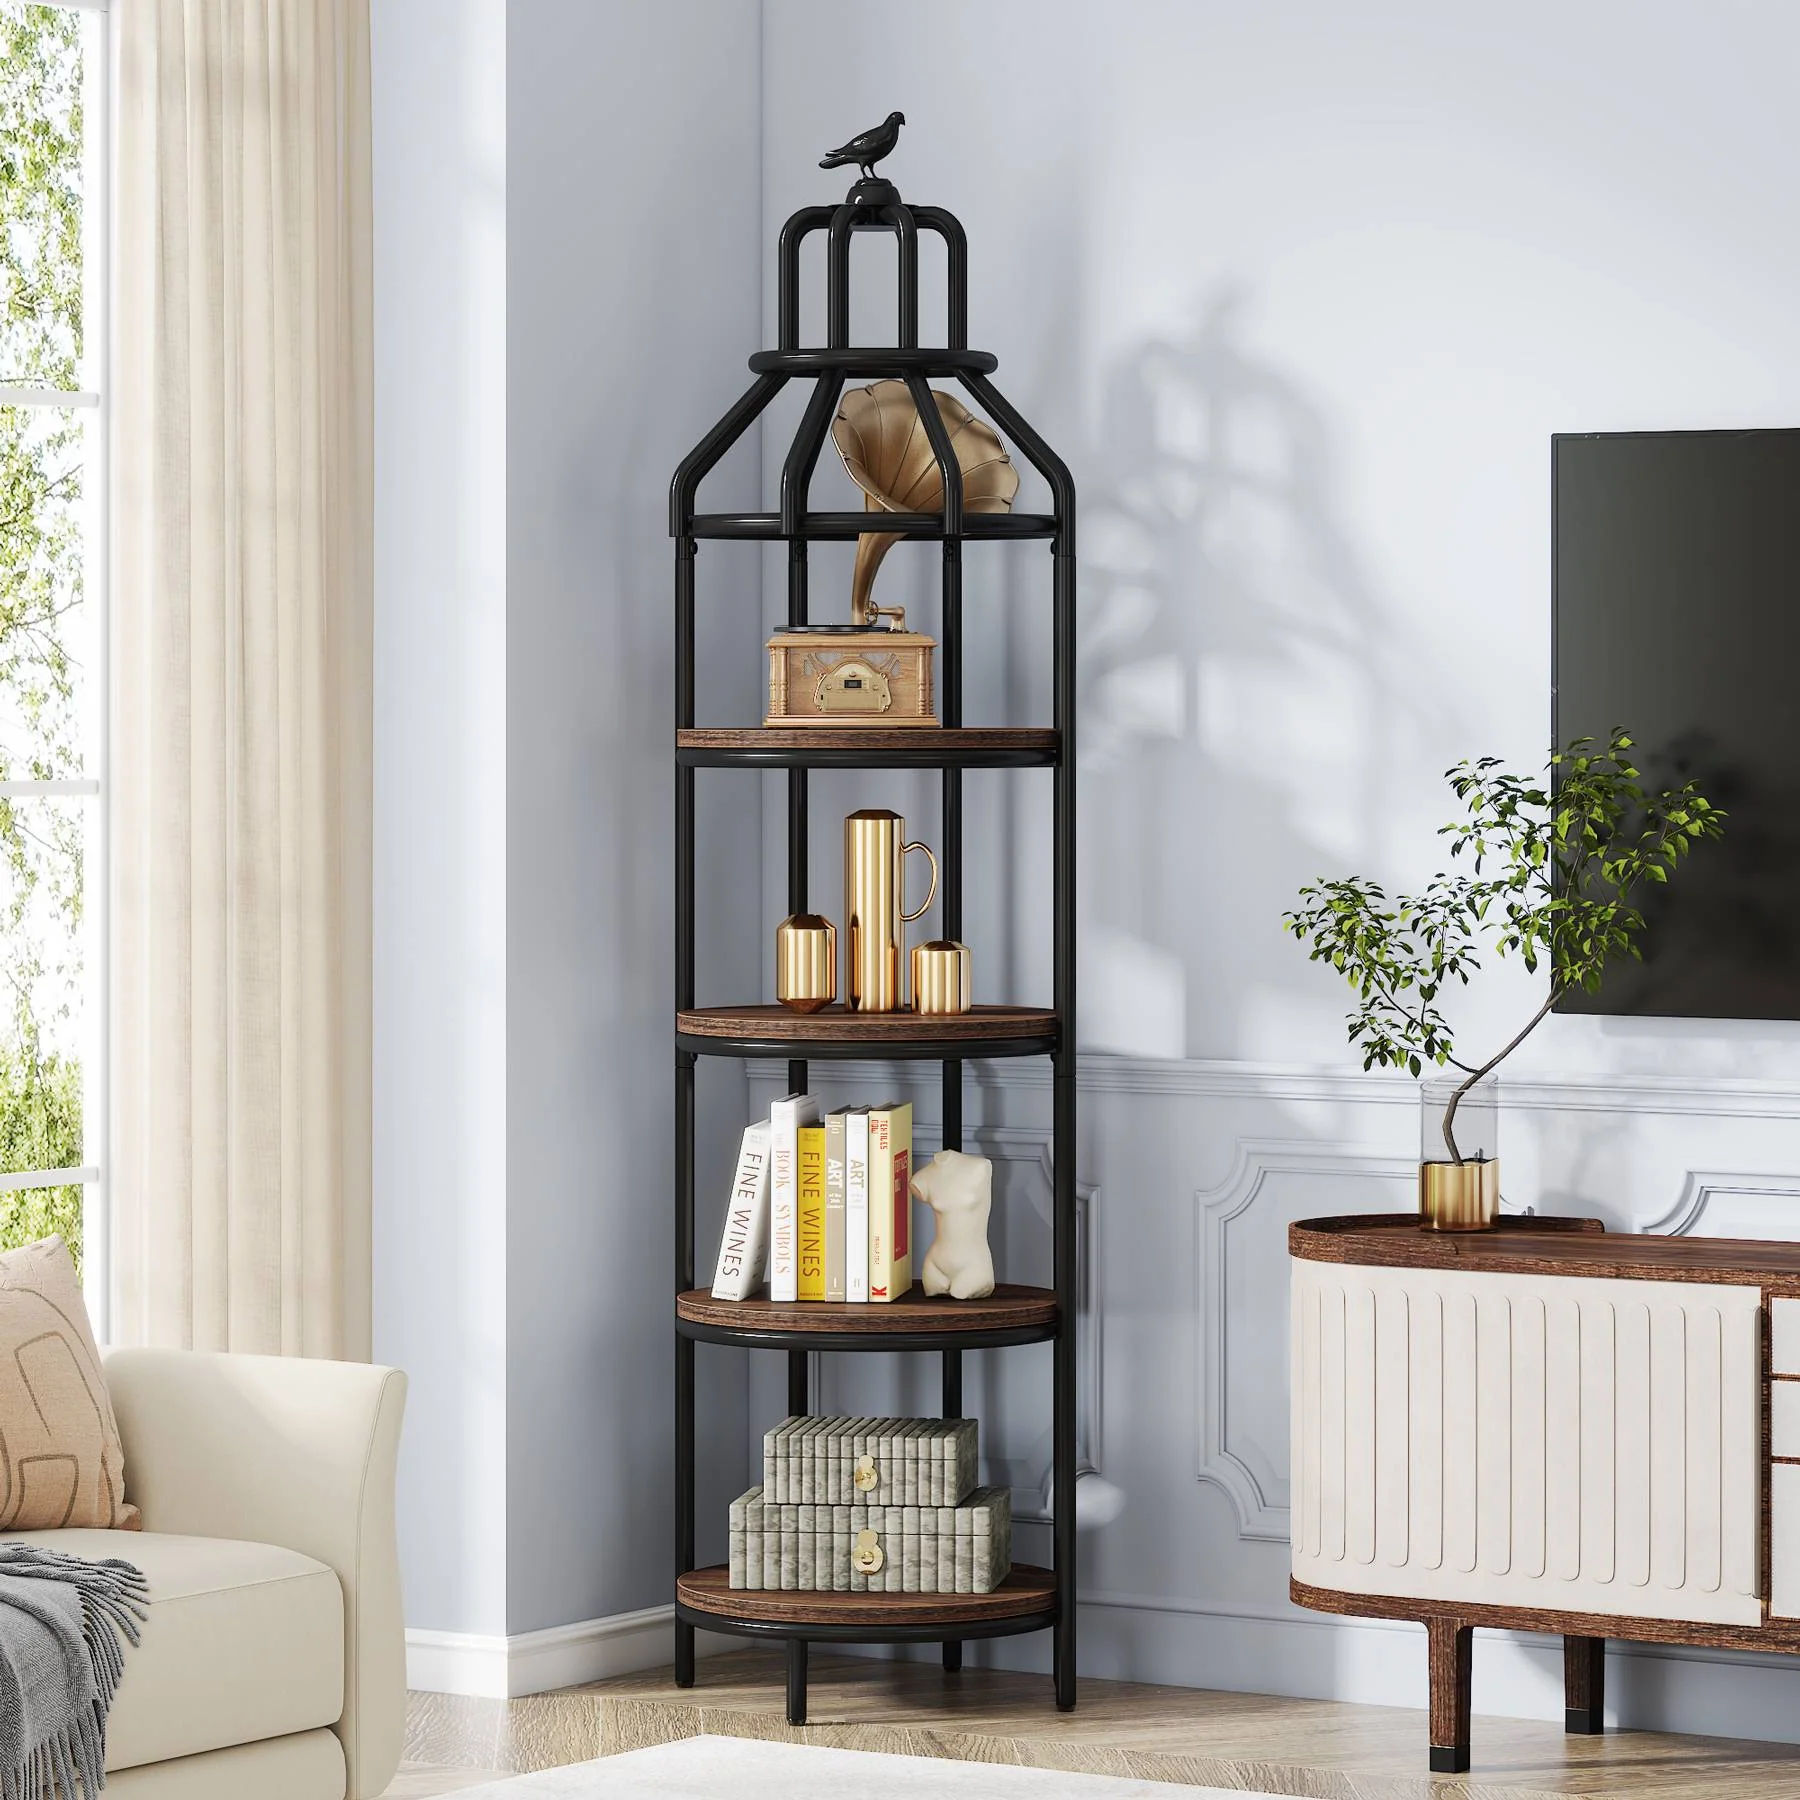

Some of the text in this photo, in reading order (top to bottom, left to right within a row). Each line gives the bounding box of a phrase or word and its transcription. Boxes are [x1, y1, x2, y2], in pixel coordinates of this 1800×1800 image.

[738, 1153, 762, 1200] FINE
[775, 1150, 790, 1189] BOOK
[802, 1152, 820, 1198] FINE
[828, 1158, 843, 1188] ART
[850, 1159, 865, 1189] ART
[723, 1209, 752, 1278] WINES
[775, 1204, 790, 1275] SYMBOLS
[802, 1208, 820, 1278] WINES
